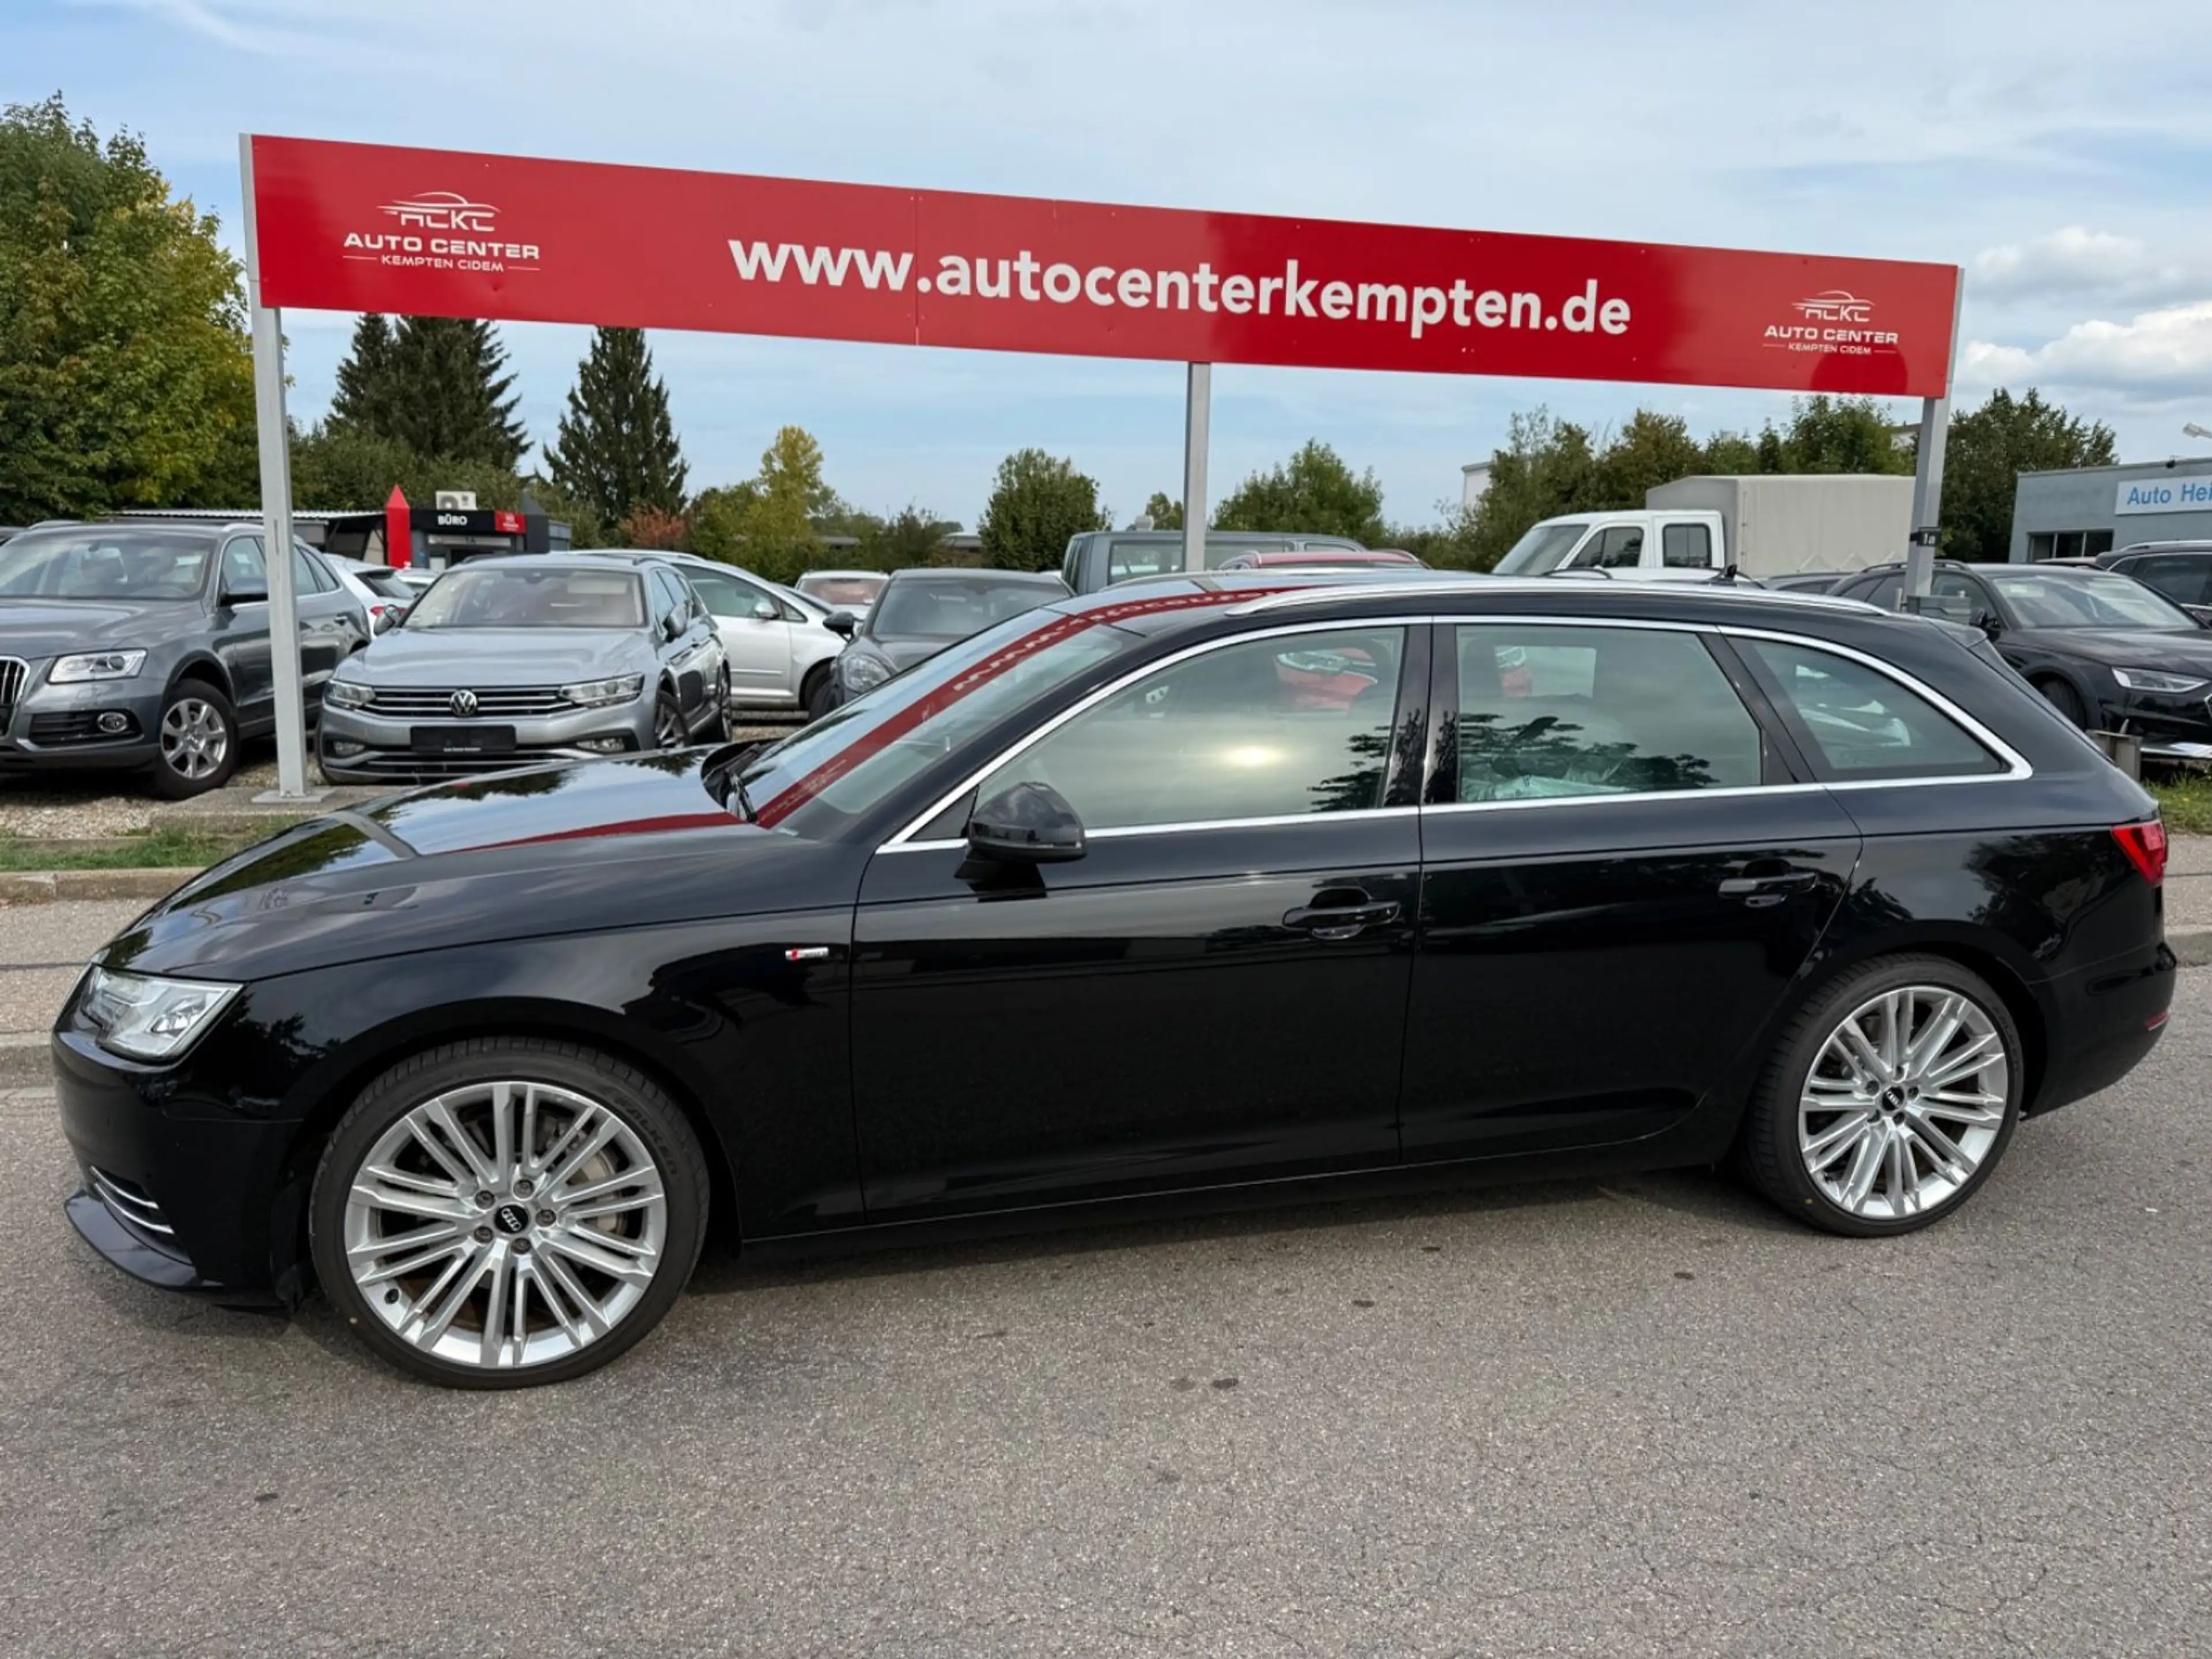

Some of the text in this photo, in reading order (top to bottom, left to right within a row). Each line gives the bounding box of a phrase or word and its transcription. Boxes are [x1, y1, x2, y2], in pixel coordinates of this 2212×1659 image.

[344, 233, 540, 259] AUTO CENTER
[381, 254, 503, 272] KEMPTEN CIDEM
[727, 239, 1631, 339] www.autocenterkempten.de
[1764, 325, 1899, 344] AUTO CENTER
[1788, 342, 1872, 355] KEMPTEN CIDEM
[2127, 486, 2172, 505] Auto
[438, 513, 468, 525] BÜRO
